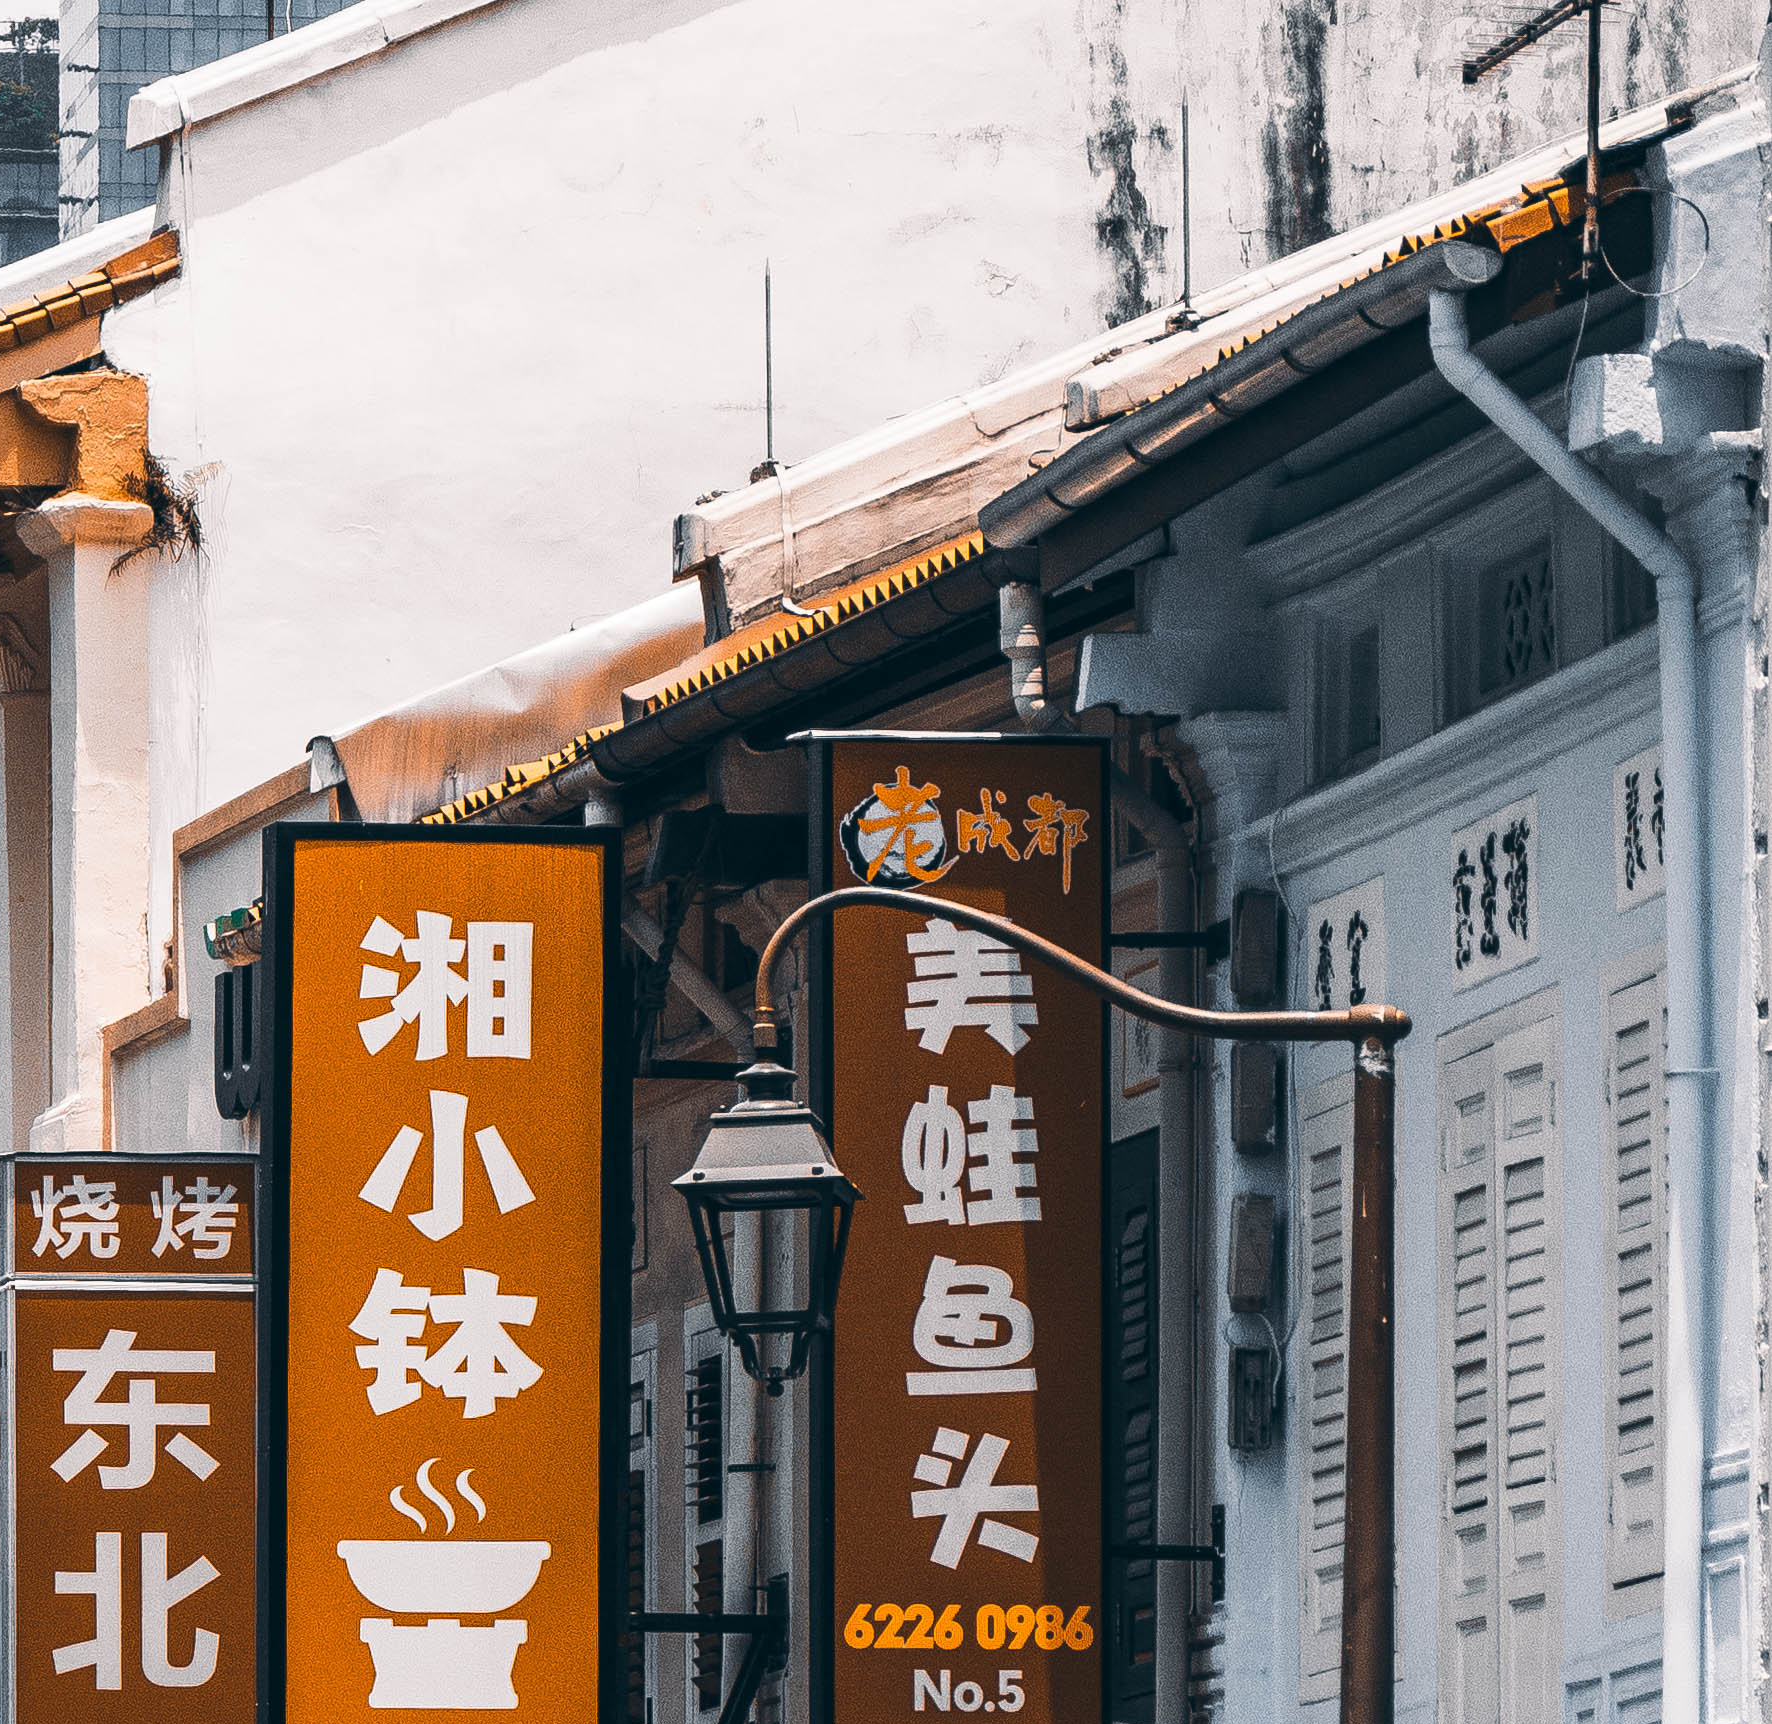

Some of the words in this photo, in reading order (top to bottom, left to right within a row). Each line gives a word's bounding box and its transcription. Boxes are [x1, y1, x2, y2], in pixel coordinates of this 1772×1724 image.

[857, 765, 1090, 894] 老成都
[31, 1175, 240, 1260] 烧烤
[358, 910, 544, 1420] 湘小钵
[903, 917, 1041, 1571] 美蛙鱼头
[845, 1604, 962, 1650] 6226
[977, 1604, 1092, 1652] 0986
[913, 1670, 1026, 1713] No.5
